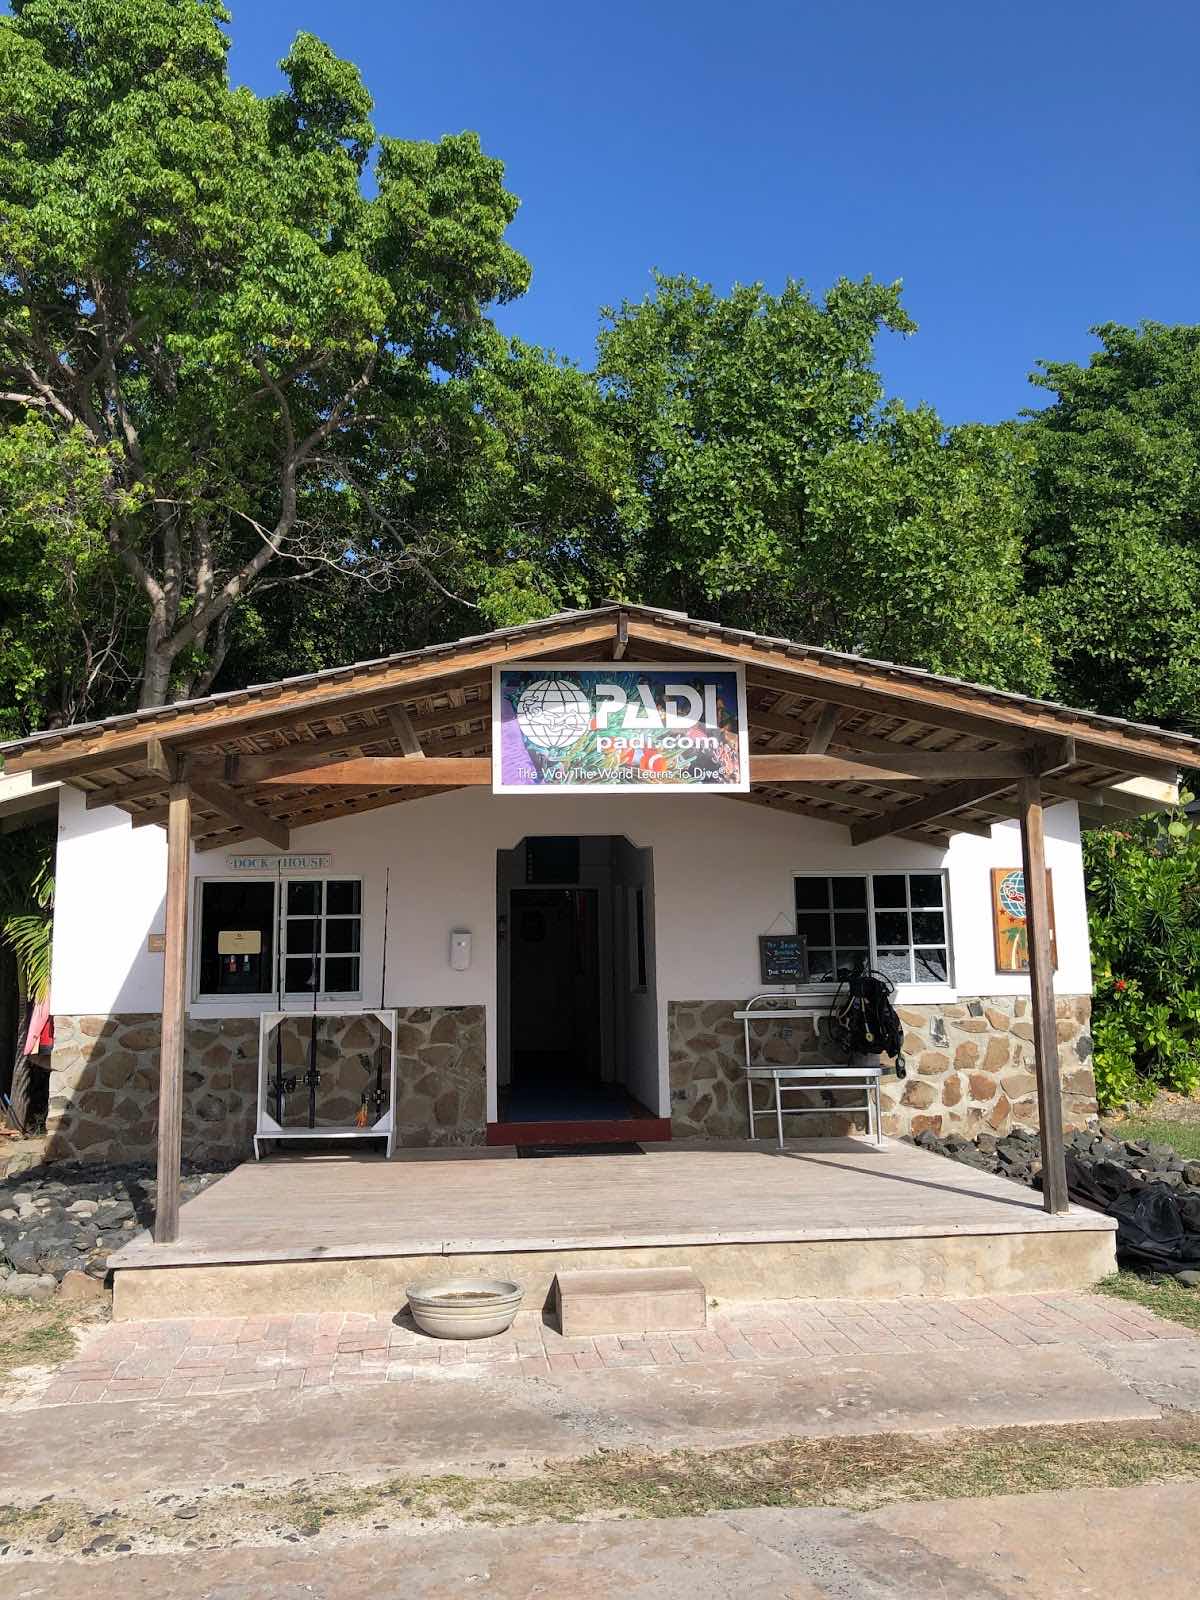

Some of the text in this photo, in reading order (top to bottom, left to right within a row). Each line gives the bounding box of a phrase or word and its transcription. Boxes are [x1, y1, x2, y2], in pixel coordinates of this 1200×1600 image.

[595, 684, 719, 729] PADI
[596, 734, 719, 752] padi.com
[518, 768, 537, 779] The
[542, 768, 570, 782] Way
[574, 767, 594, 779] The
[598, 767, 633, 779] World
[638, 767, 673, 779] Learns
[679, 767, 690, 779] To
[232, 858, 327, 869] DOCK HOUSE
